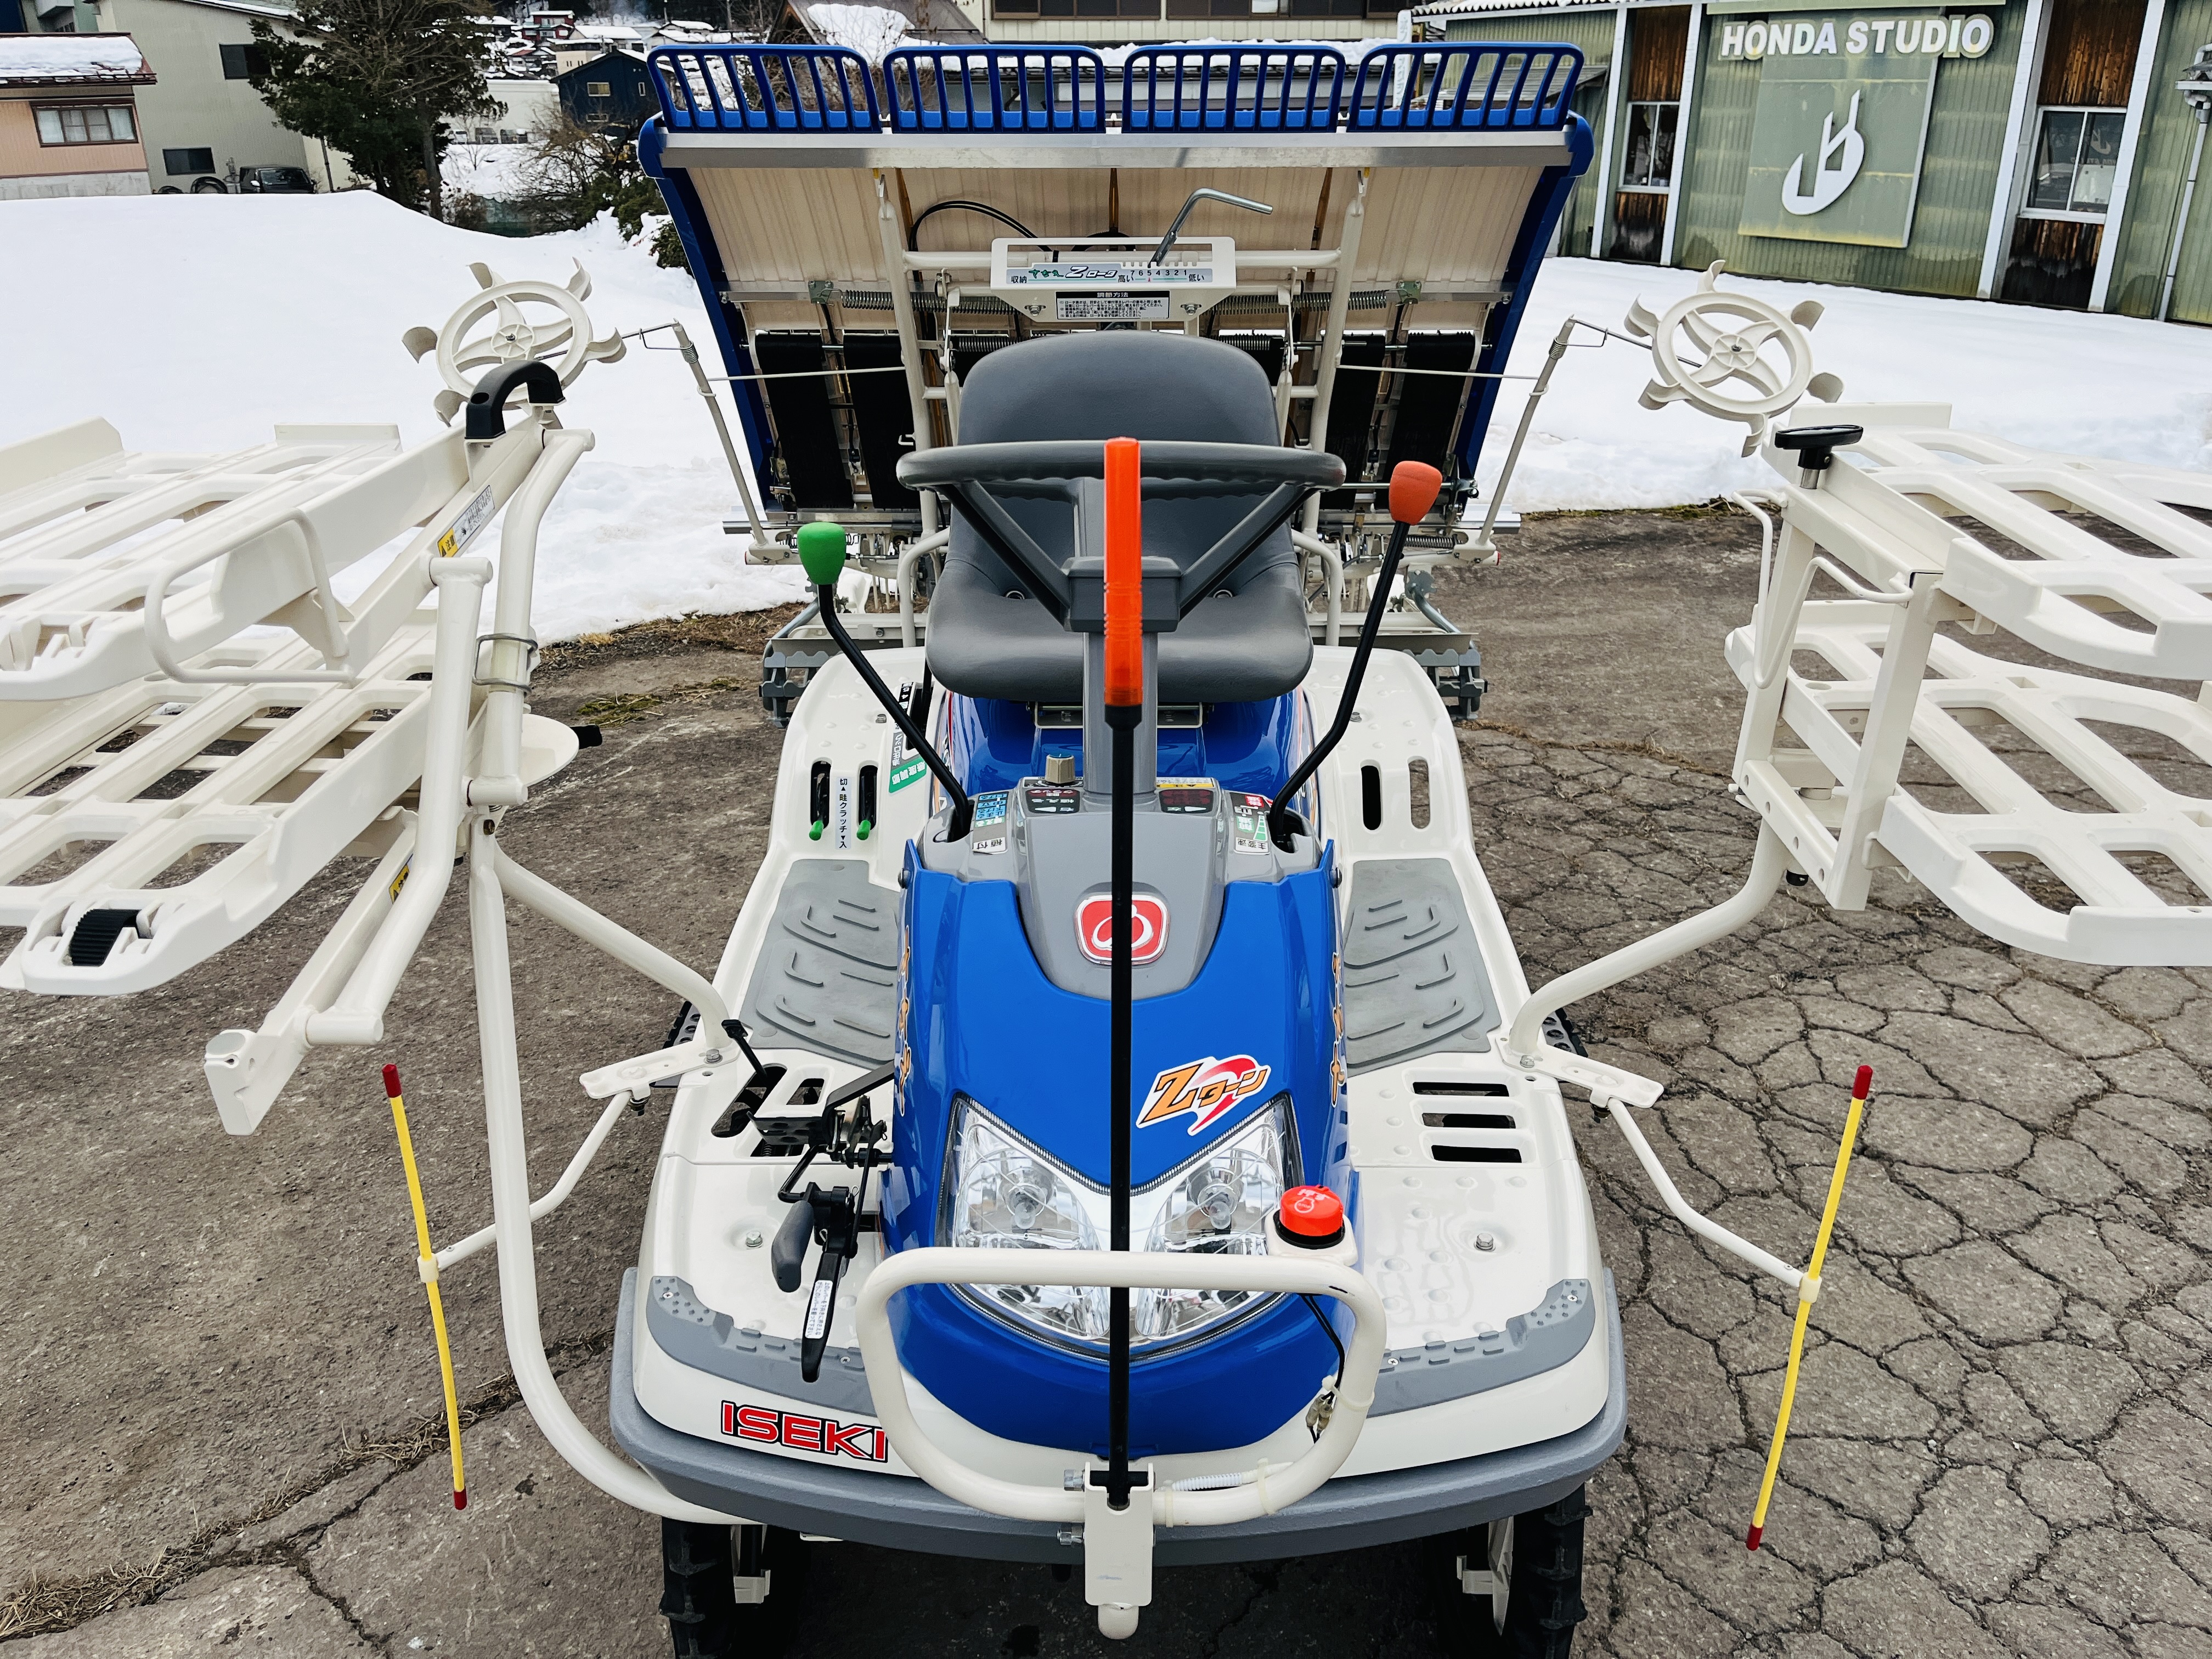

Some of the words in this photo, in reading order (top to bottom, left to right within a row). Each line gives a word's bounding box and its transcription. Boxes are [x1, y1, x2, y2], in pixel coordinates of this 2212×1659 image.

[1721, 21, 1837, 57] HONDA
[1846, 16, 1991, 54] STUDIO
[892, 733, 903, 766] 油圧ロック
[839, 794, 848, 833] 畦クラッチ
[977, 839, 1002, 849] 植付
[1237, 838, 1267, 849] 主変速
[1139, 1061, 1268, 1124] Zターン
[721, 1401, 889, 1463] ISEKI
